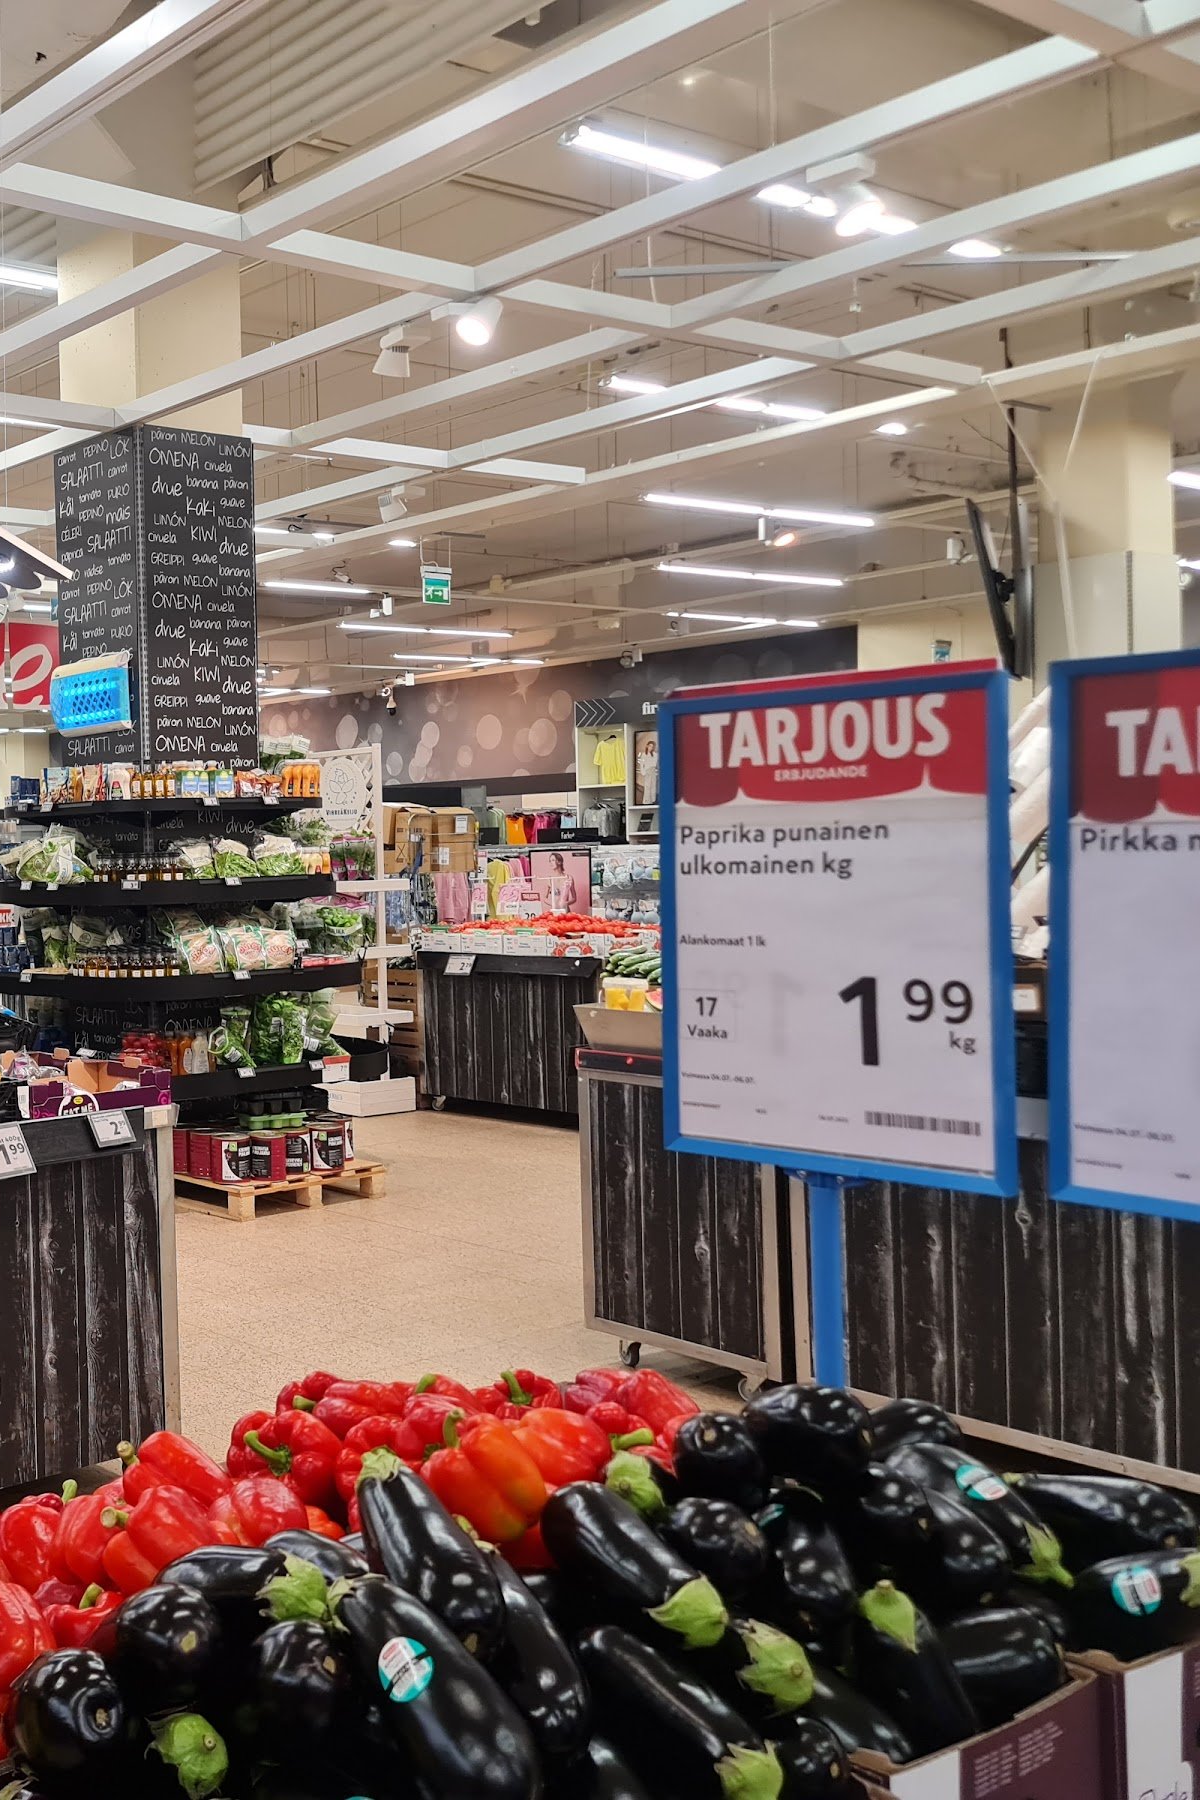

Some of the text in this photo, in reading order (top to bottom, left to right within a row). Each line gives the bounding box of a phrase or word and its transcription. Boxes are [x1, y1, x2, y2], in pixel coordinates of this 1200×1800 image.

[83, 439, 109, 458] PEPINO
[181, 432, 216, 446] MELON
[149, 447, 232, 473] OMENA ciruela
[61, 462, 103, 491] SALAATTI
[152, 475, 183, 496] drue
[186, 475, 219, 490] banana
[79, 504, 131, 525] PEPINO mais
[218, 515, 251, 529] MELON
[87, 525, 131, 553] SALAATTI
[148, 525, 249, 556] ciruela KIWI drue
[151, 552, 184, 566] GREIPPI
[219, 564, 250, 577] banana
[87, 579, 112, 595] PEPINO
[184, 574, 218, 587] MELON
[64, 600, 107, 625] SALAATTI
[152, 591, 235, 613] OMENA ciruela
[155, 619, 186, 638] drue
[189, 617, 221, 629] banana
[221, 655, 255, 667] MELON
[151, 665, 252, 694] ciruela KIWI drue
[154, 695, 188, 708] GREIPPI
[222, 704, 254, 715] banana
[187, 716, 221, 728] MELON
[699, 692, 951, 769] TARJOUS
[67, 736, 110, 758] SALAATTI
[155, 735, 238, 755] OMENA ciruela
[1105, 706, 1200, 778] TA
[774, 764, 868, 781] ERBJUDANDE
[225, 816, 256, 834] drue
[680, 820, 889, 849] Paprika punainen
[1081, 826, 1178, 851] Pirkka
[680, 852, 853, 879] ulkomainen kg
[680, 935, 744, 946] Alankomaat
[75, 1006, 119, 1025] SALAATTI
[696, 996, 718, 1017] 17
[687, 1024, 728, 1039] Vaaka
[839, 976, 879, 1066] 1
[949, 1032, 977, 1055] kg
[109, 1121, 121, 1136] 2
